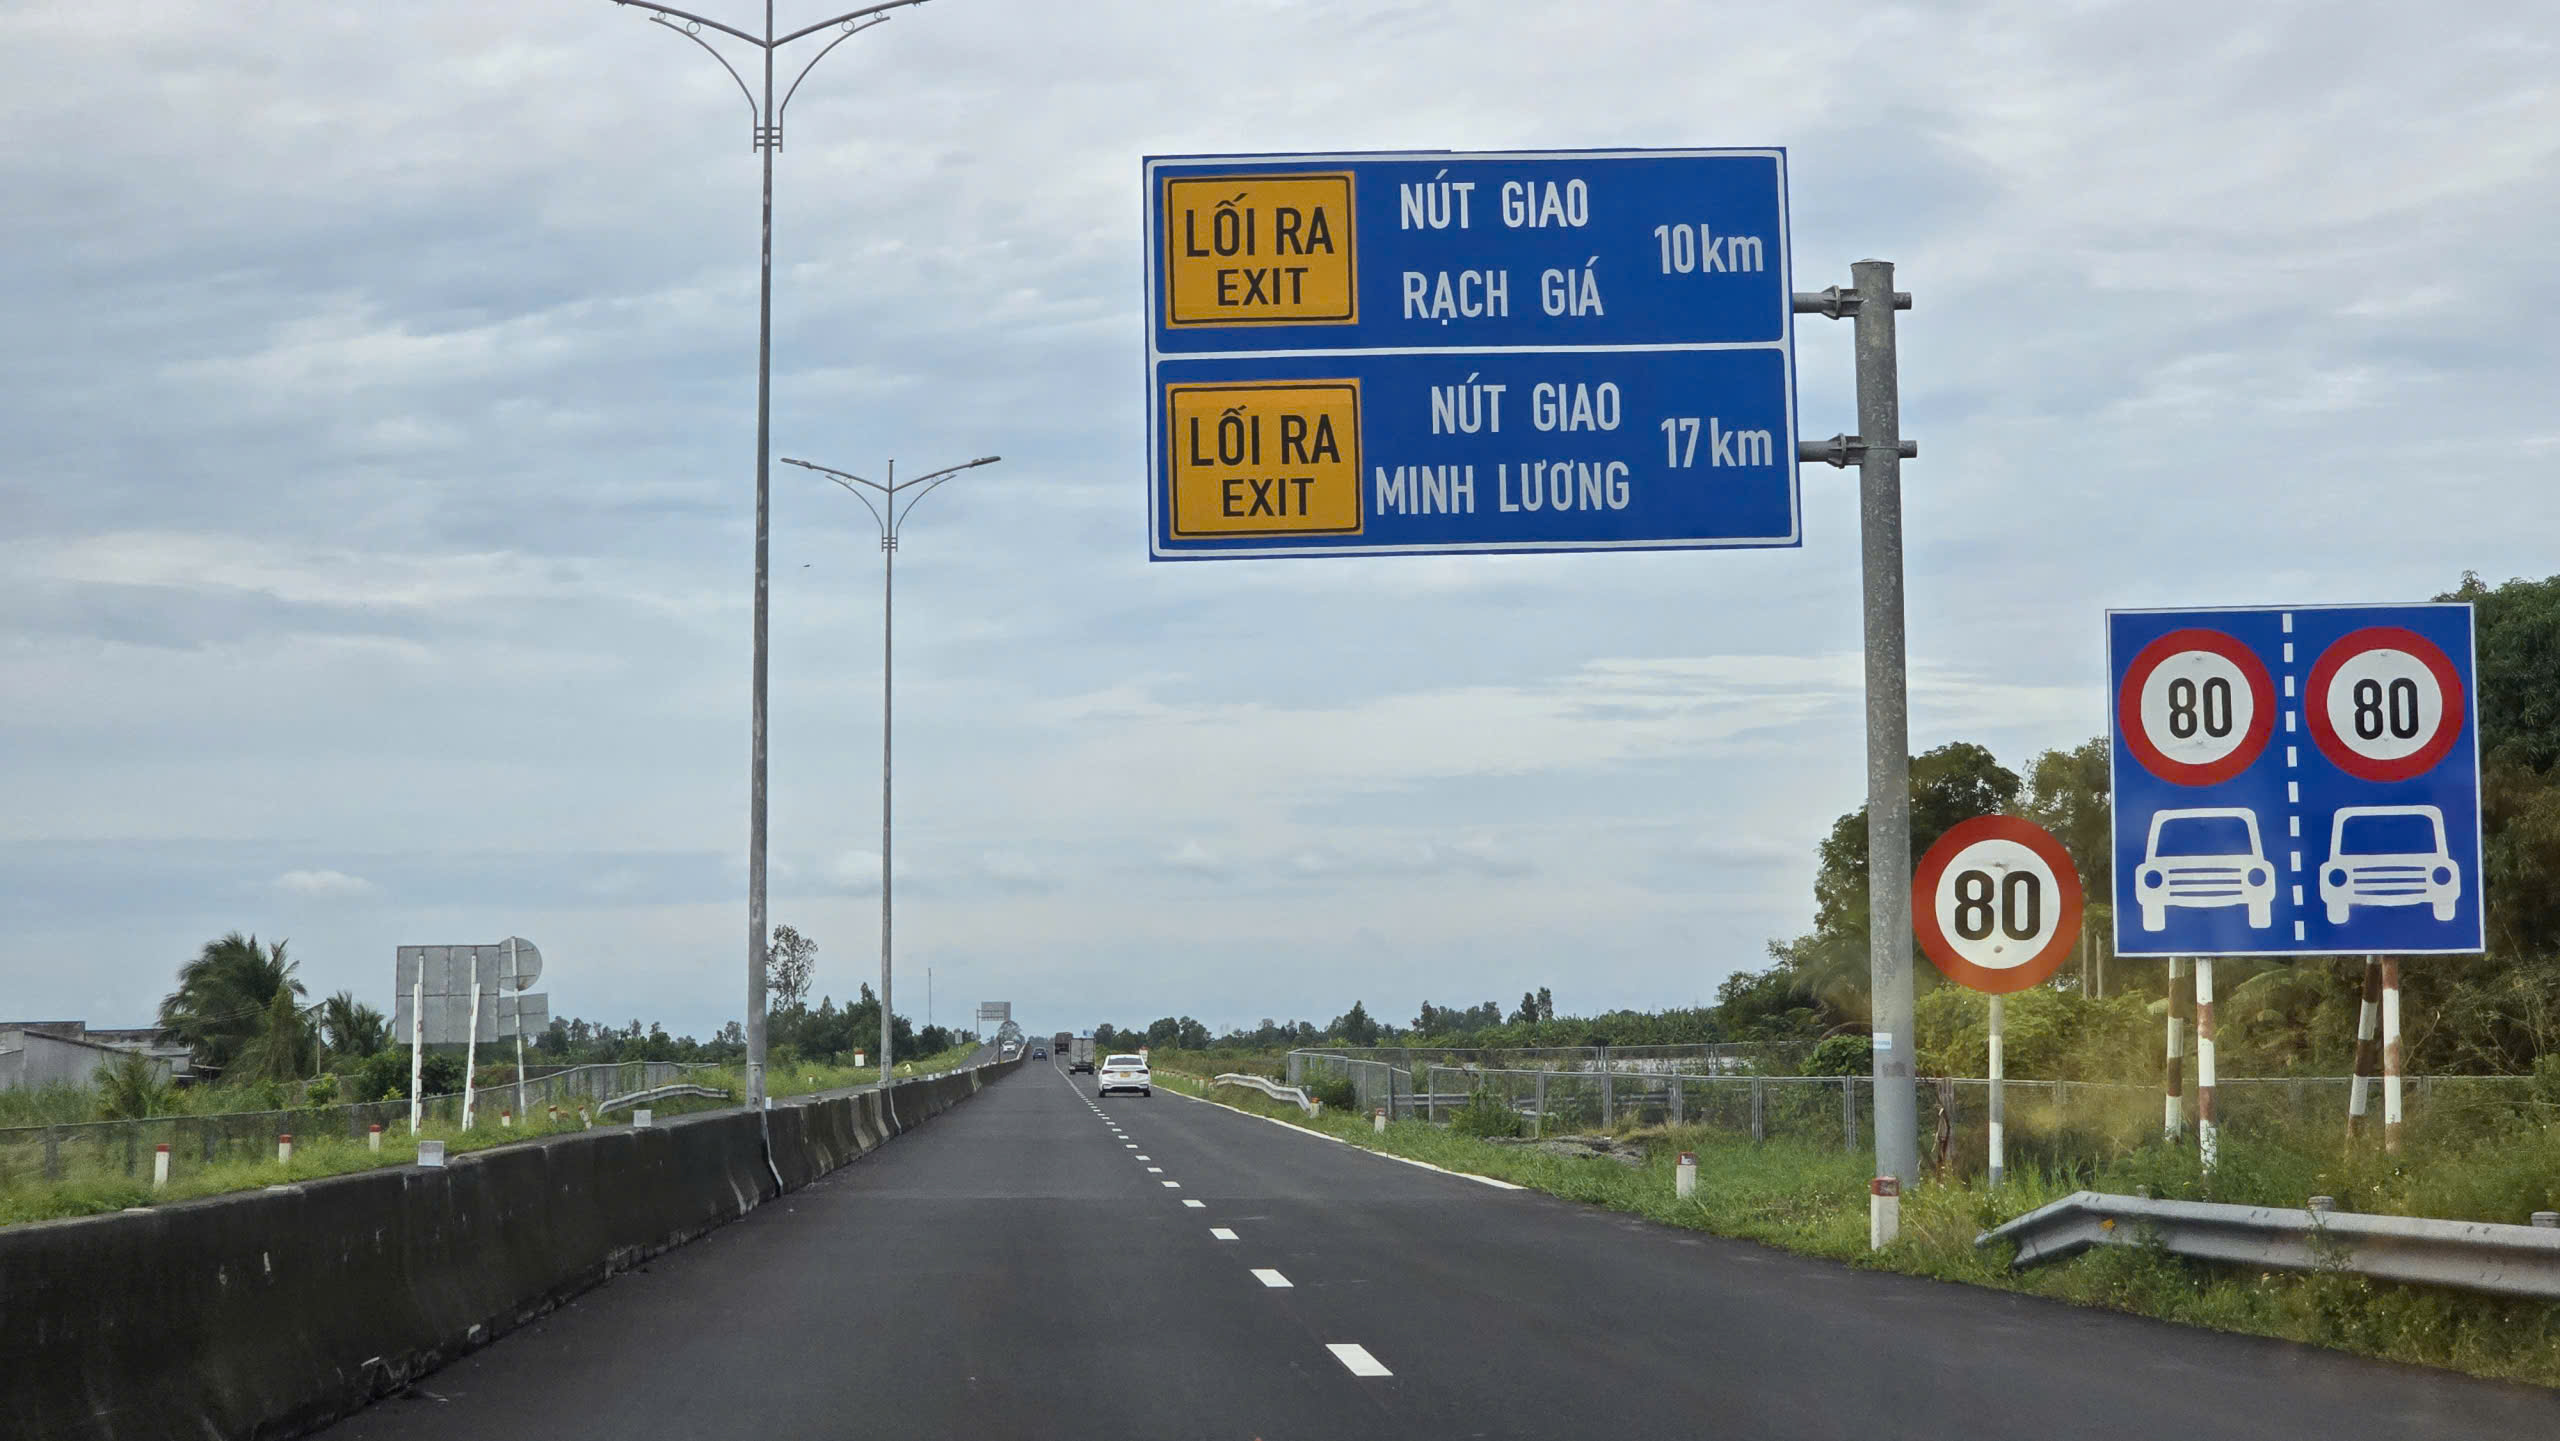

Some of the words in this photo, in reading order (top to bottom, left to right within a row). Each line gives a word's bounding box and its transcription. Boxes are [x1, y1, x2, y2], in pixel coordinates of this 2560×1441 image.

[1187, 193, 1255, 257] LỐI
[1275, 207, 1335, 256] RA
[1400, 169, 1474, 229] NÚT
[1501, 178, 1588, 228] GIAO
[1217, 267, 1309, 307] EXIT
[1403, 269, 1508, 326] RẠCH
[1541, 255, 1604, 317] GIÁ
[1432, 372, 1506, 434] NÚT
[1533, 381, 1621, 432] GIAO
[1190, 404, 1260, 467] LỐI
[1280, 413, 1341, 465] RA
[1222, 477, 1315, 518] EXIT
[1375, 465, 1475, 516] MINH
[1498, 459, 1630, 513] LƯƠNG
[2168, 676, 2233, 739] 80
[2353, 677, 2419, 741] 80
[1954, 869, 2041, 941] 80
